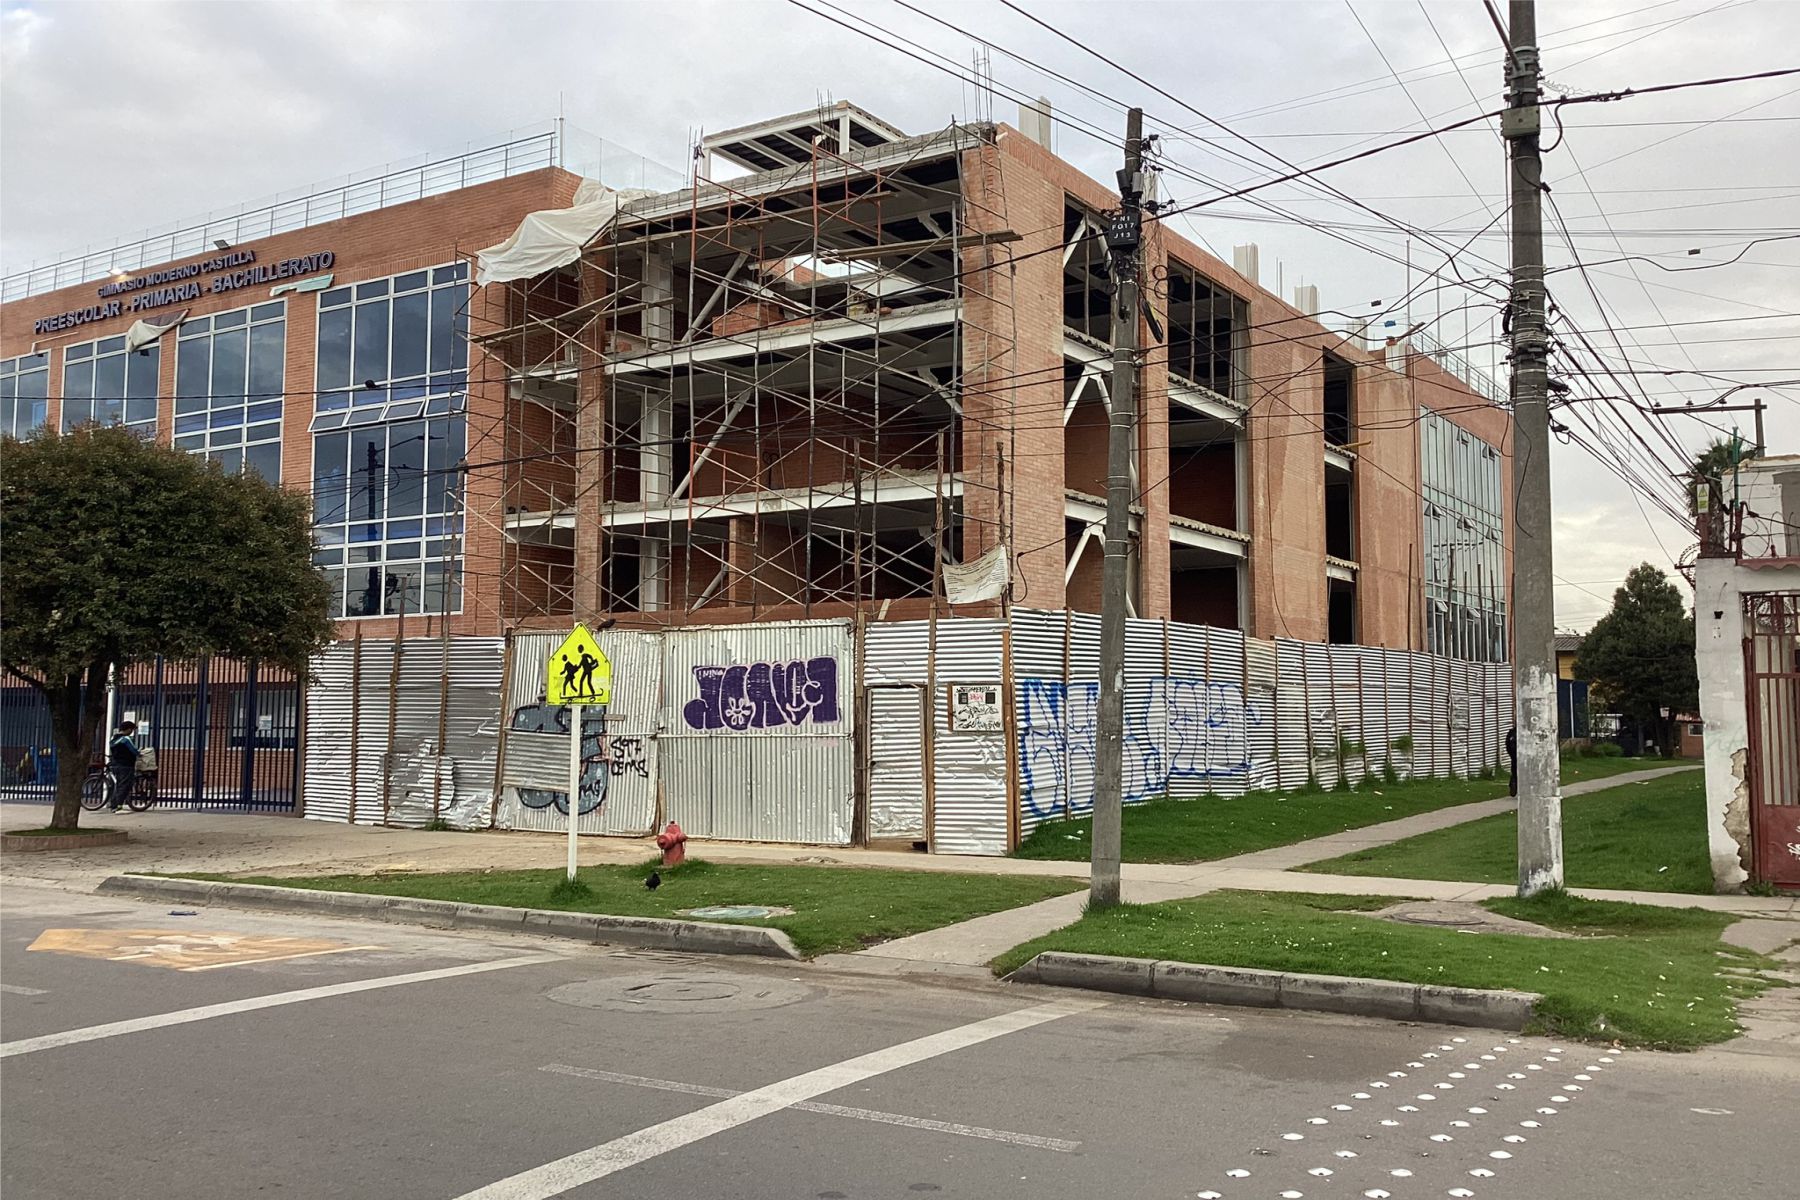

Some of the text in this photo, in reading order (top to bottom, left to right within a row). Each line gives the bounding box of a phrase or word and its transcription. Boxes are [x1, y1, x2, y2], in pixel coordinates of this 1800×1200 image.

[34, 300, 121, 334] PREESCOLAR
[131, 282, 201, 312] PRIMARIA
[212, 250, 335, 293] BACHILLERATO
[97, 250, 255, 297] GIMNASIO MODERNO CASTILLA
